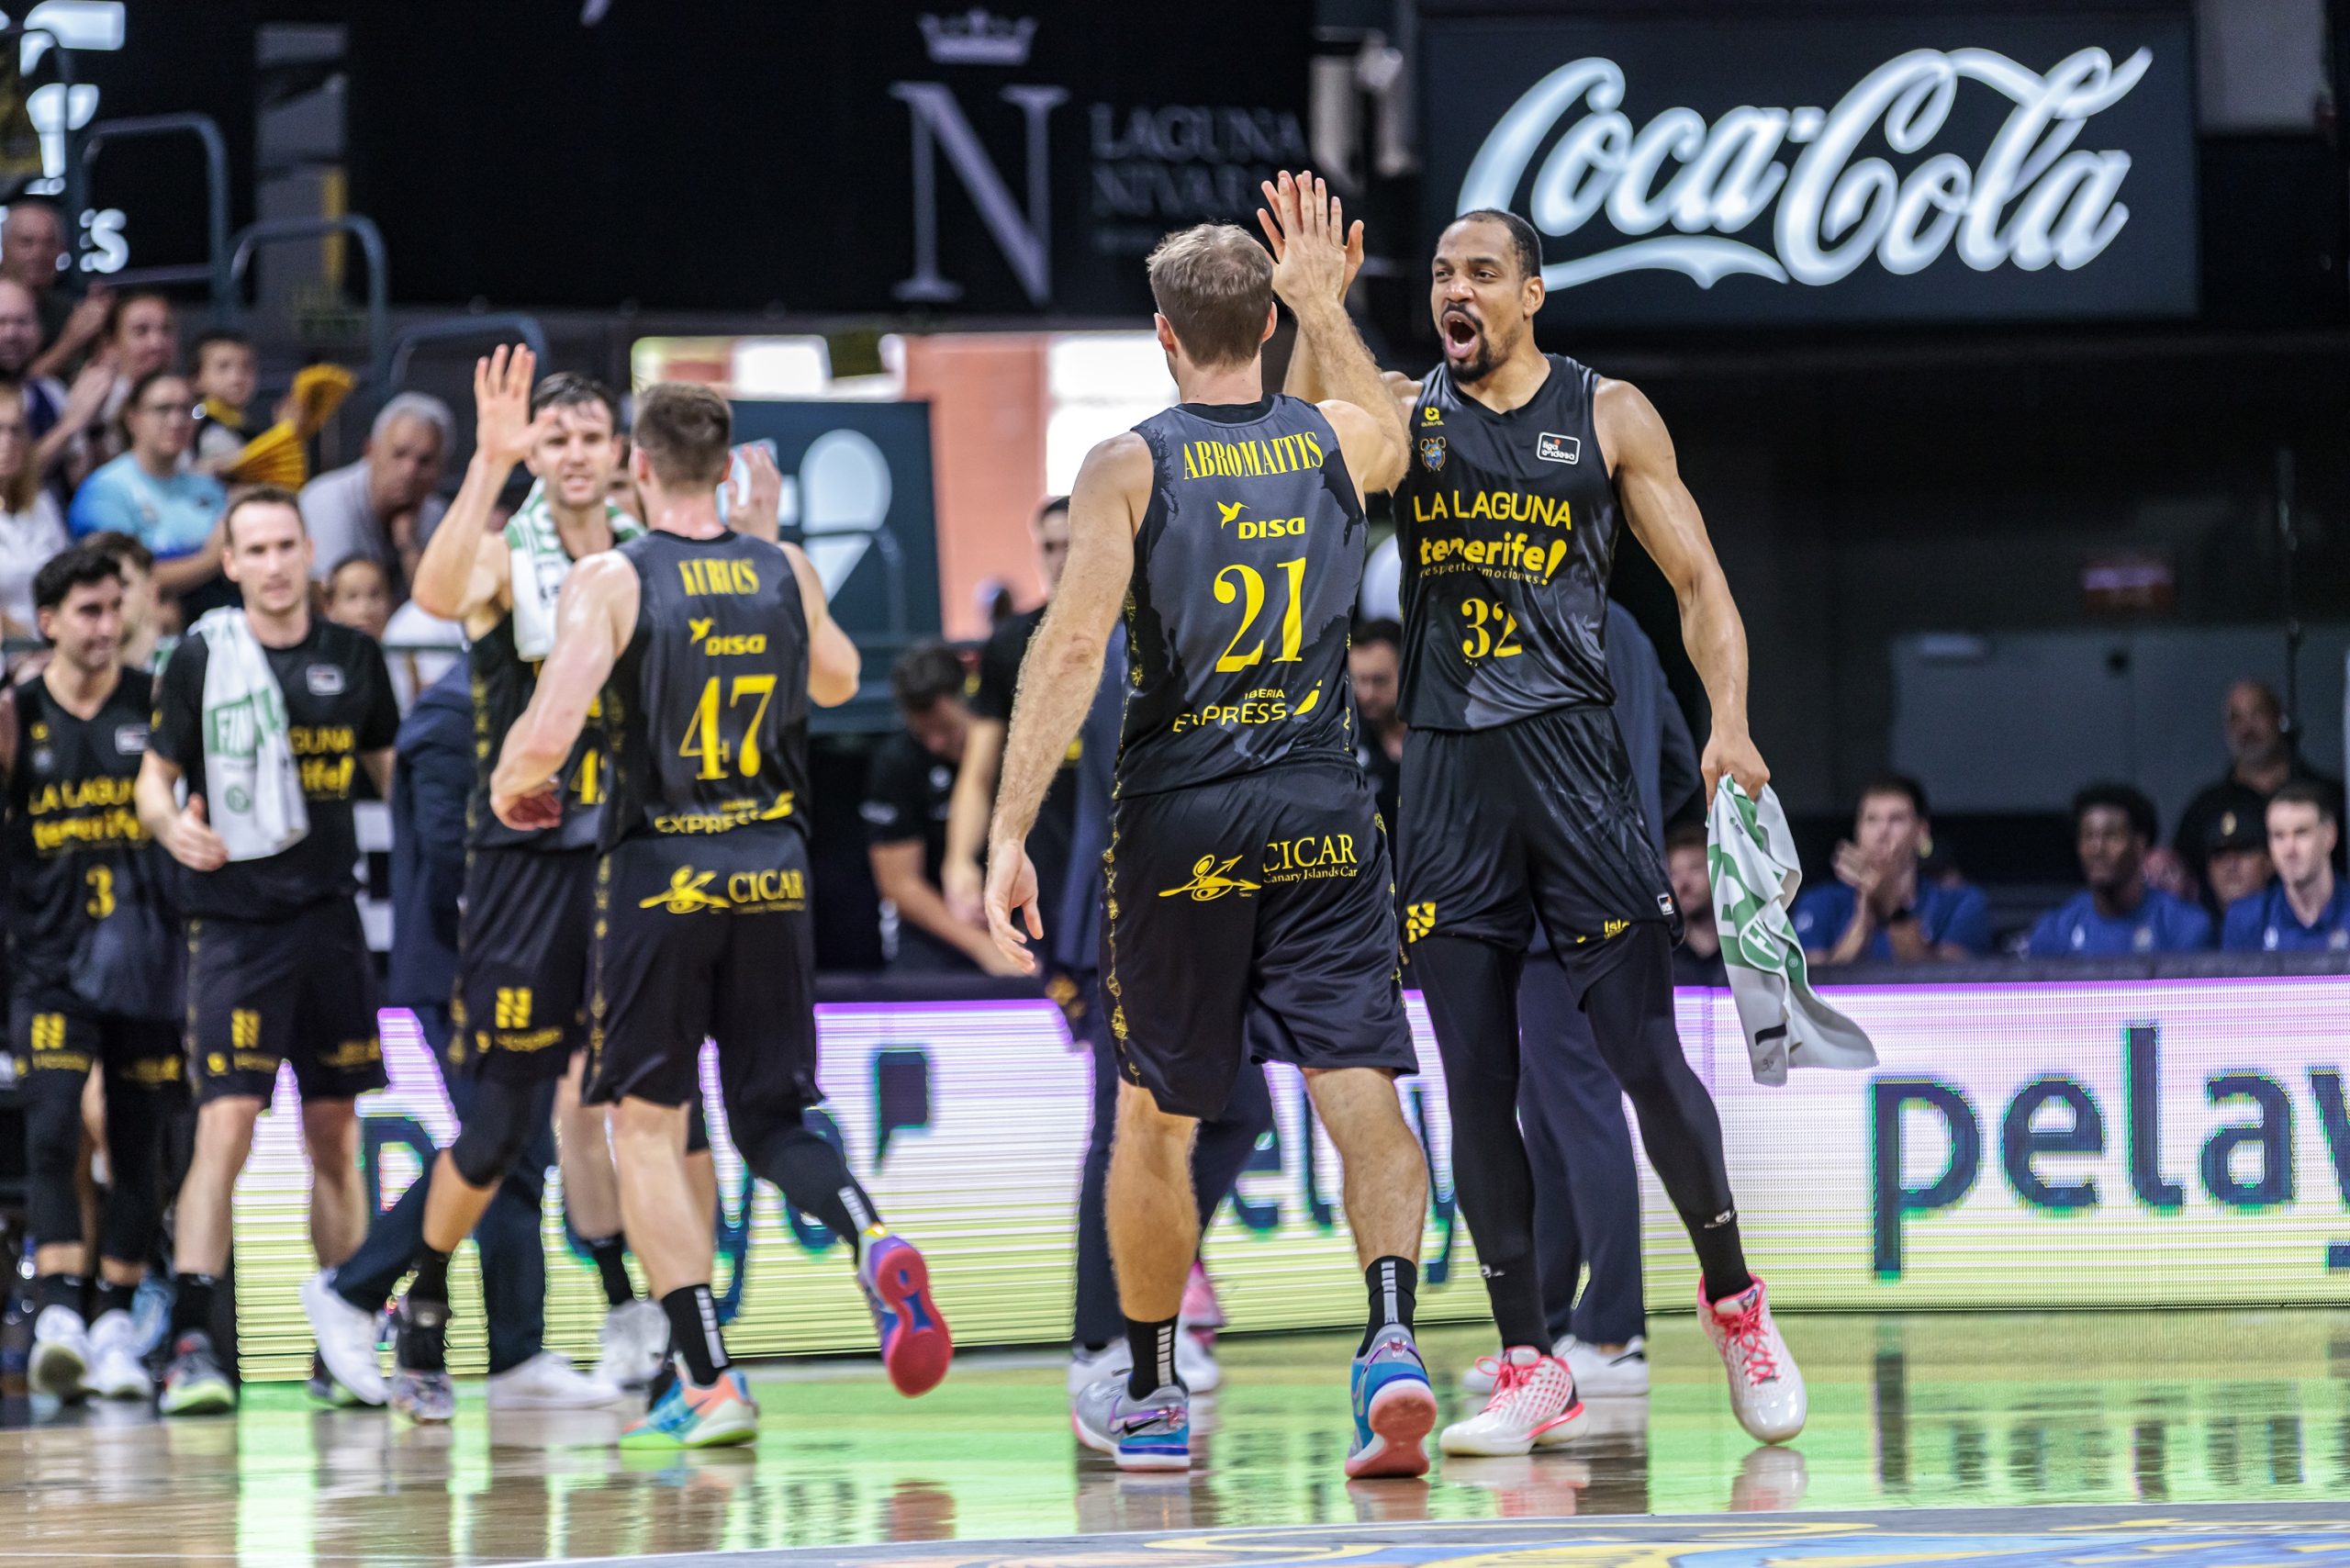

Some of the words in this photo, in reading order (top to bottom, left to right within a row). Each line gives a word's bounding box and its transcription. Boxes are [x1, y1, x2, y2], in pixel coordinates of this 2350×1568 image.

[1183, 431, 1324, 480] ABROMAITIS
[1414, 491, 1449, 523] LA
[1454, 489, 1572, 531] LAGUNA
[1214, 556, 1306, 673] 21
[1461, 598, 1522, 658] 32
[1245, 689, 1285, 700] IBERIA
[678, 674, 778, 779] 47
[1263, 834, 1358, 872] CICAR
[1304, 867, 1338, 880] Islands
[1340, 866, 1358, 878] Car
[85, 865, 116, 918] 3
